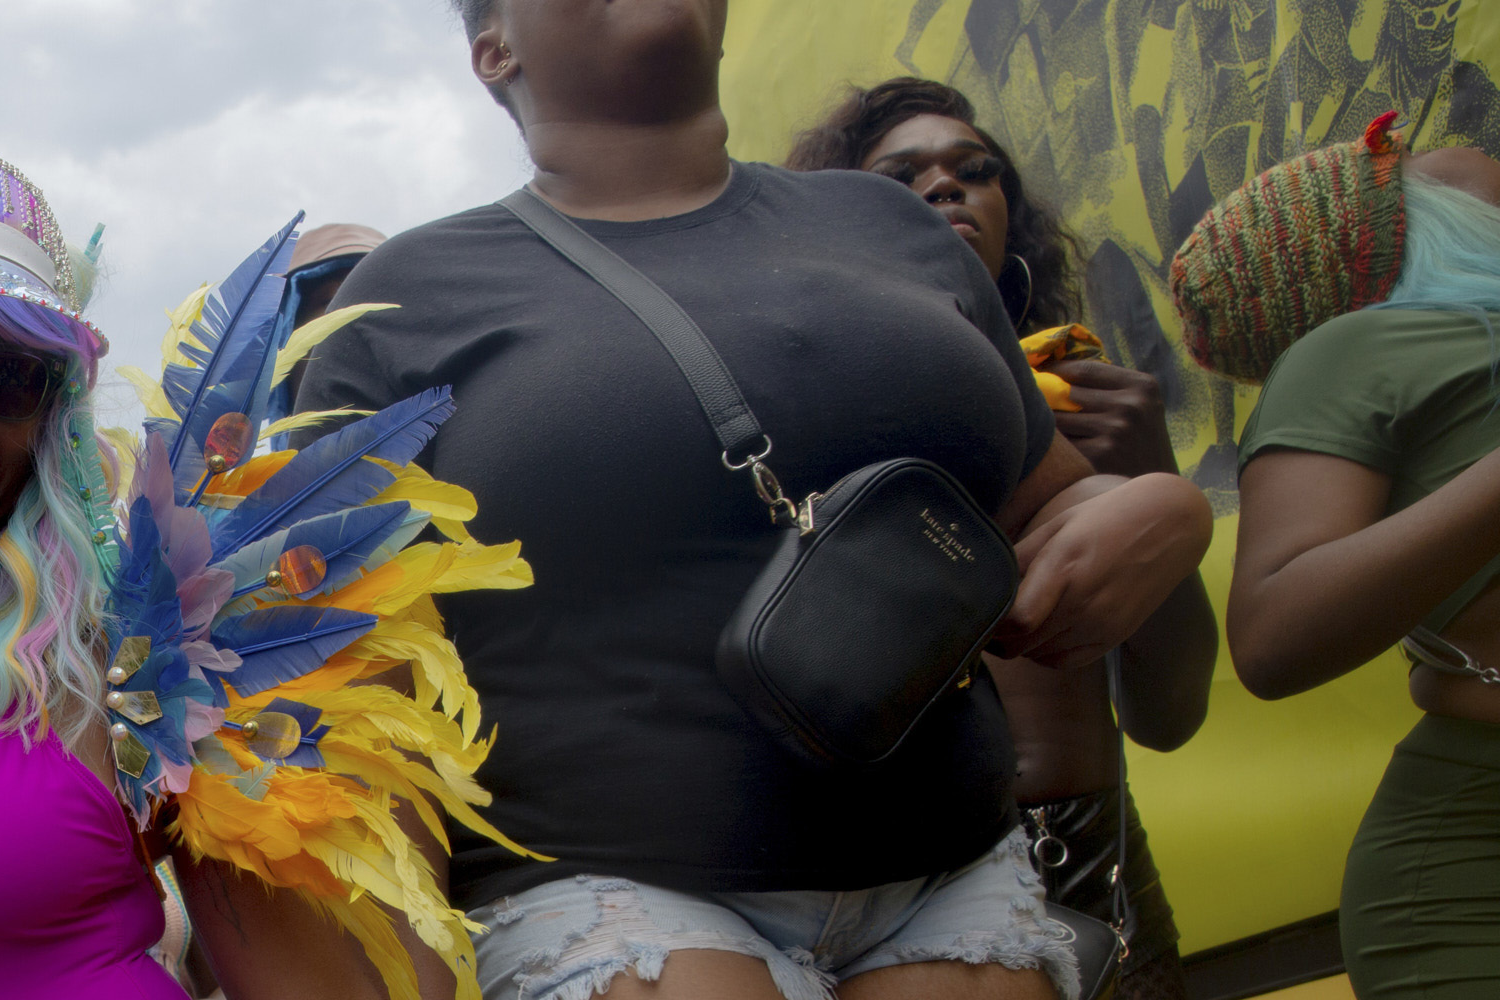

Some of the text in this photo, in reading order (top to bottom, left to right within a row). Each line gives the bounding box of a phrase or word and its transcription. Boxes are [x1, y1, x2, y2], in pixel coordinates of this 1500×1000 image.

[920, 508, 975, 561] kate spade
[923, 529, 959, 561] NEW YORK
